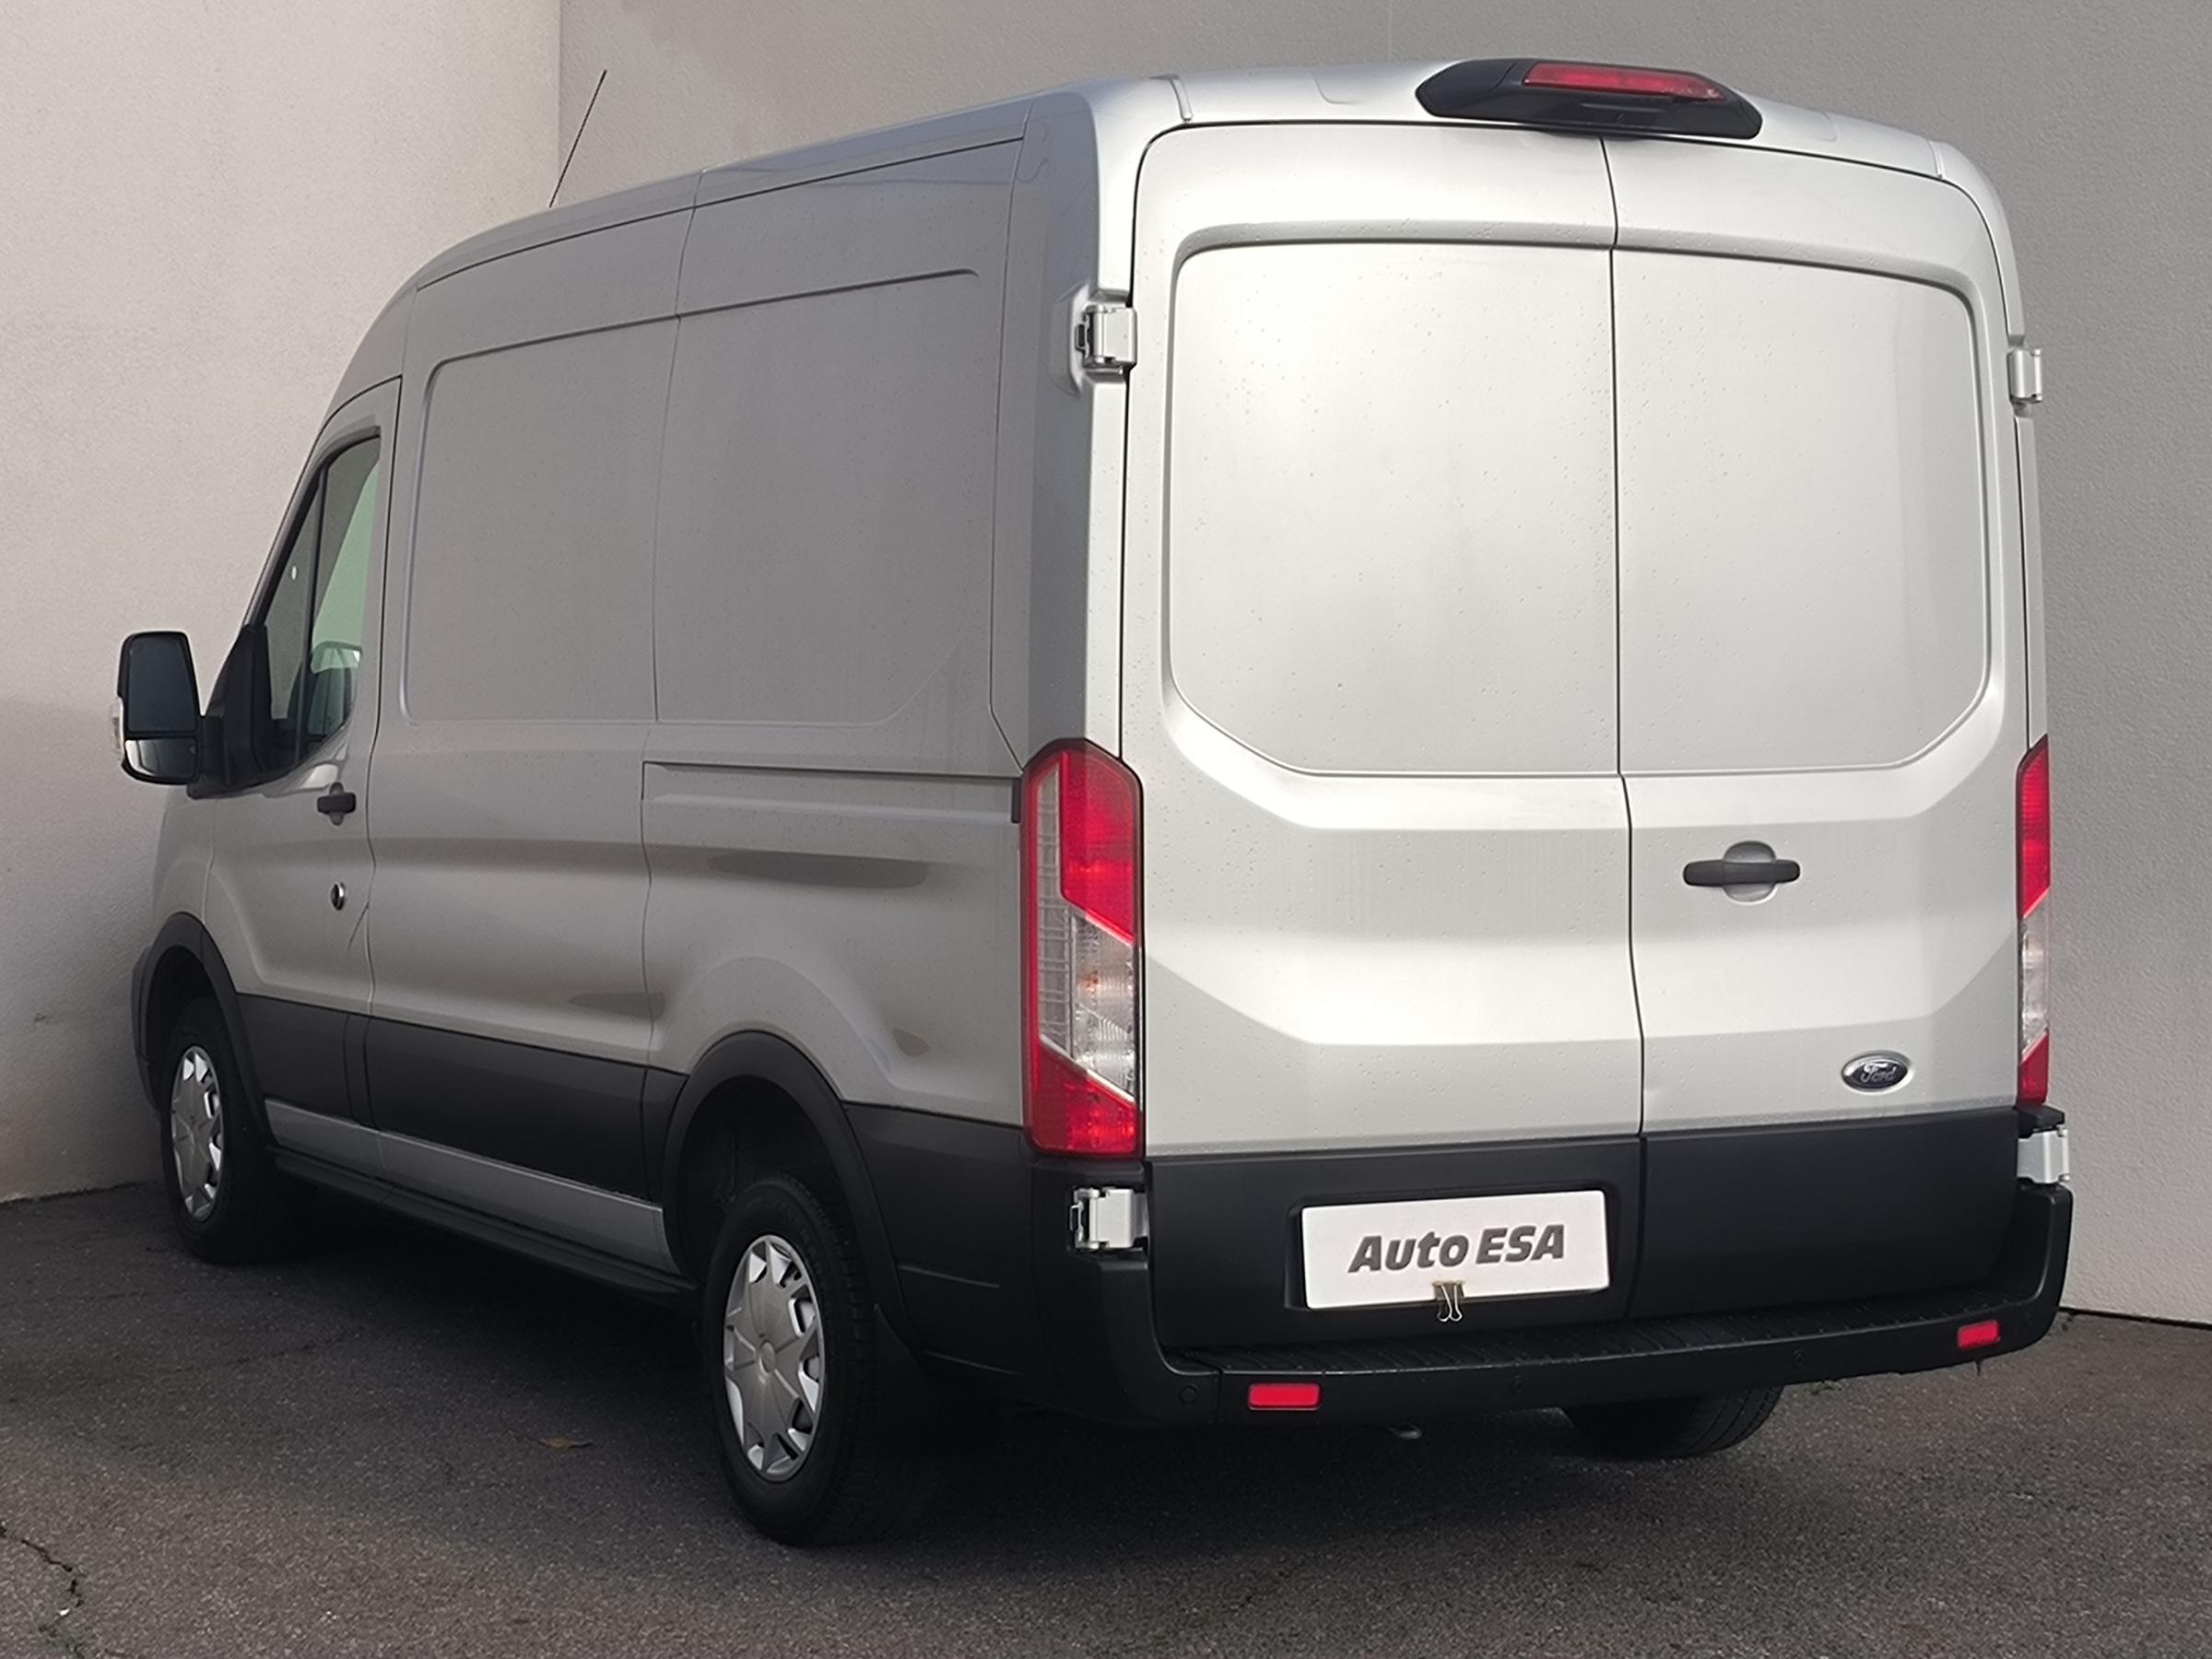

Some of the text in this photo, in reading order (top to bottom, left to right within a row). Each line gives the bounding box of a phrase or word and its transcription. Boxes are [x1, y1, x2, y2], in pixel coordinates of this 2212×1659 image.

[1860, 1062, 1898, 1083] Ford
[1347, 1224, 1565, 1273] Auto ESA
